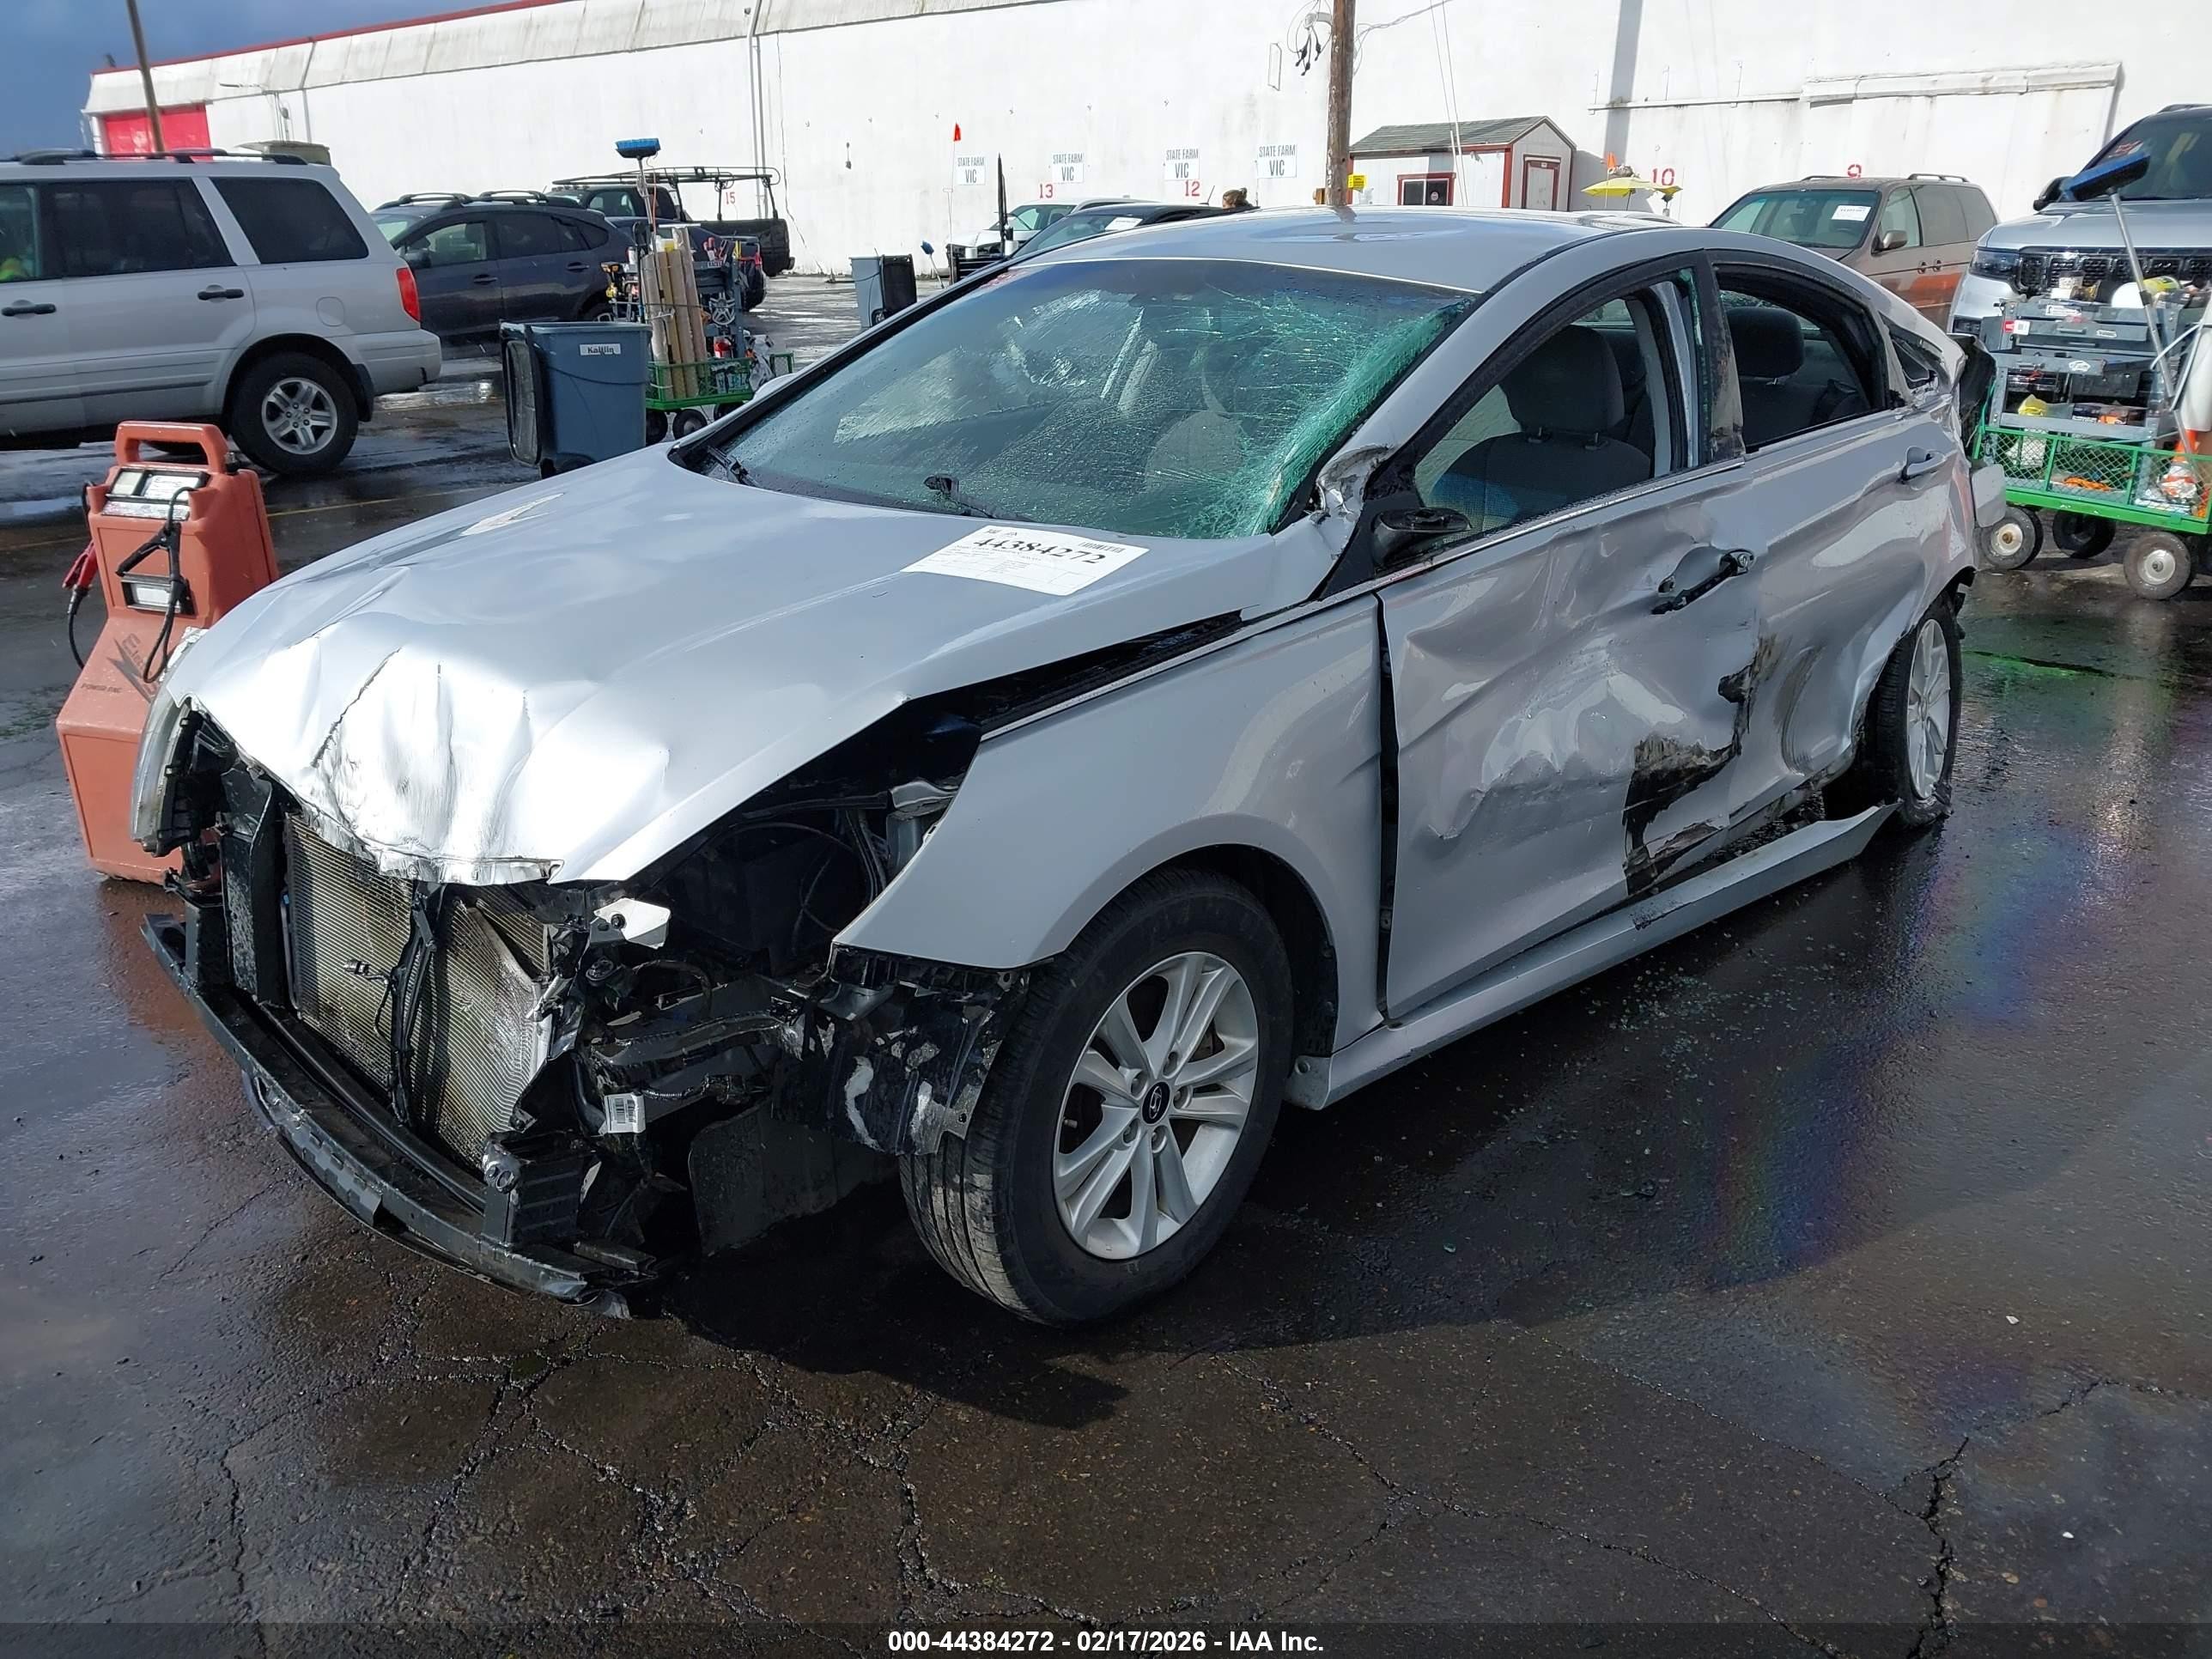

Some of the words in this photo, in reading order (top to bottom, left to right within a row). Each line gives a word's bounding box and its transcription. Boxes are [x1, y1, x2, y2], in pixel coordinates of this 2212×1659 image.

[1166, 149, 1181, 161] STATE
[1182, 149, 1199, 159] FARM
[1259, 146, 1276, 157] STATE
[1278, 144, 1296, 156] FARM
[957, 157, 970, 167] STATE
[971, 157, 985, 166] FARM
[1053, 154, 1066, 164] STATE
[1068, 153, 1083, 163] FARM
[1061, 167, 1074, 181] VIC
[1175, 162, 1189, 179] VIC
[1269, 160, 1285, 176] VIC
[965, 169, 977, 183] VIC
[1652, 167, 1675, 186] 10
[1040, 183, 1054, 198] 13
[1185, 180, 1200, 197] 12
[726, 191, 736, 204] 15
[974, 538, 1106, 564] 44384272
